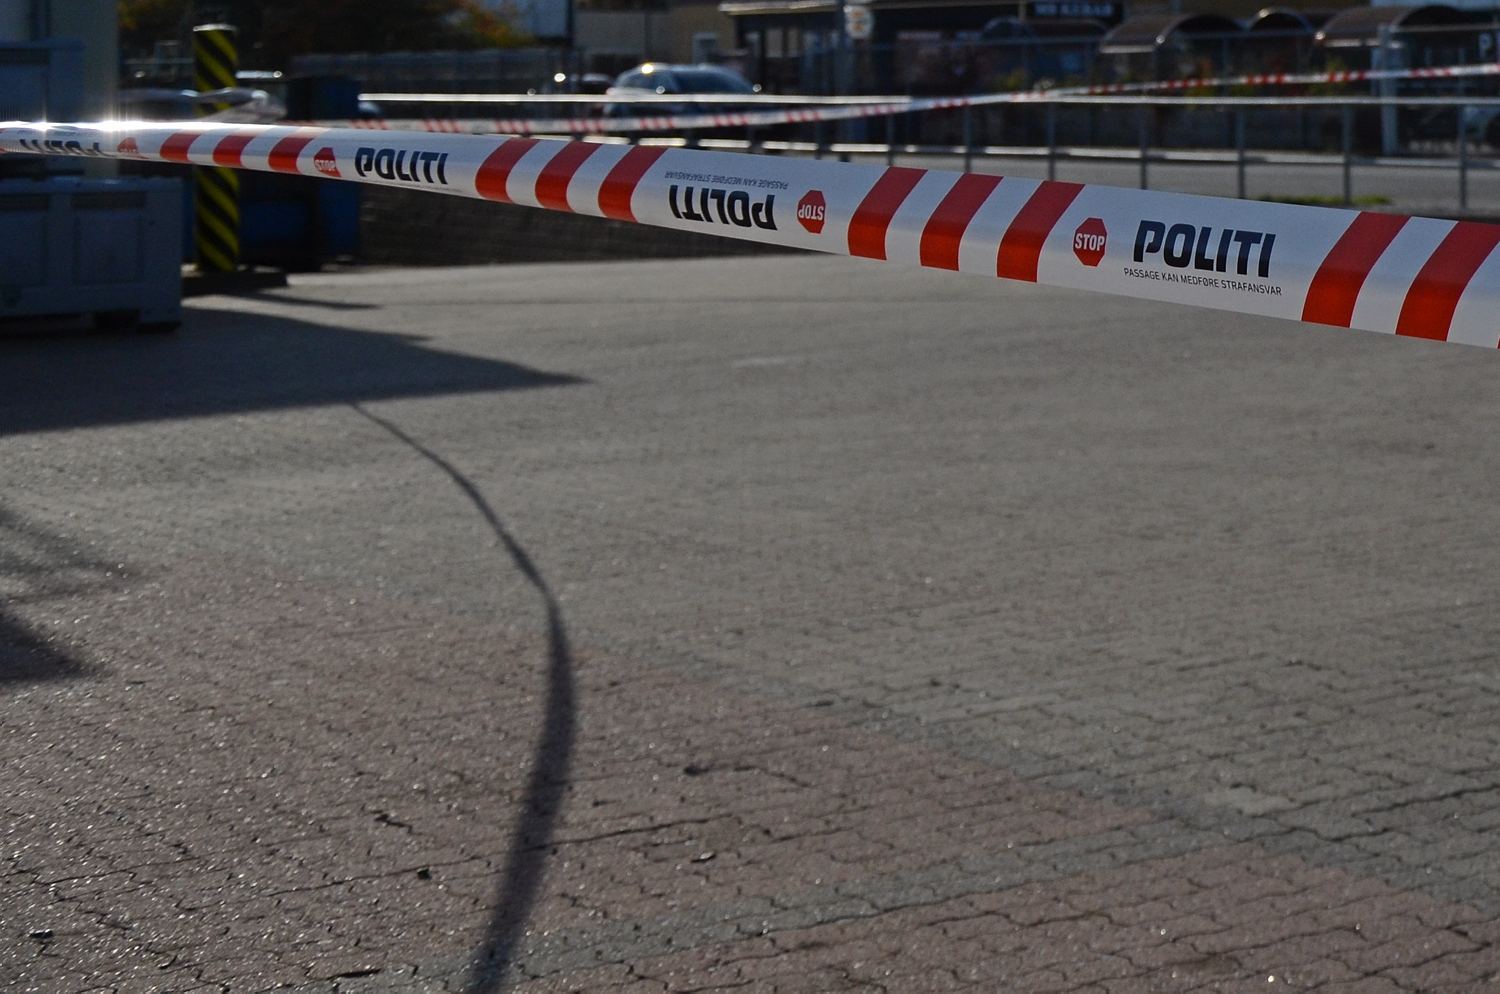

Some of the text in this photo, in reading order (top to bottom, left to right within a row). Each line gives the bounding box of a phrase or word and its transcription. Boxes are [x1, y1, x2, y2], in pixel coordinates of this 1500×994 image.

[314, 159, 336, 172] STOP
[354, 147, 449, 185] POLITI
[664, 171, 789, 190] PASSAGE KAN MEDFØRE STRAFANSVAR
[668, 184, 778, 231] POLITI
[797, 204, 825, 221] STOP
[1074, 232, 1106, 252] STOP
[1133, 219, 1277, 278] POLITI
[1123, 267, 1283, 296] PASSAGE KAN MEDFØRE STRAFANSVAR
